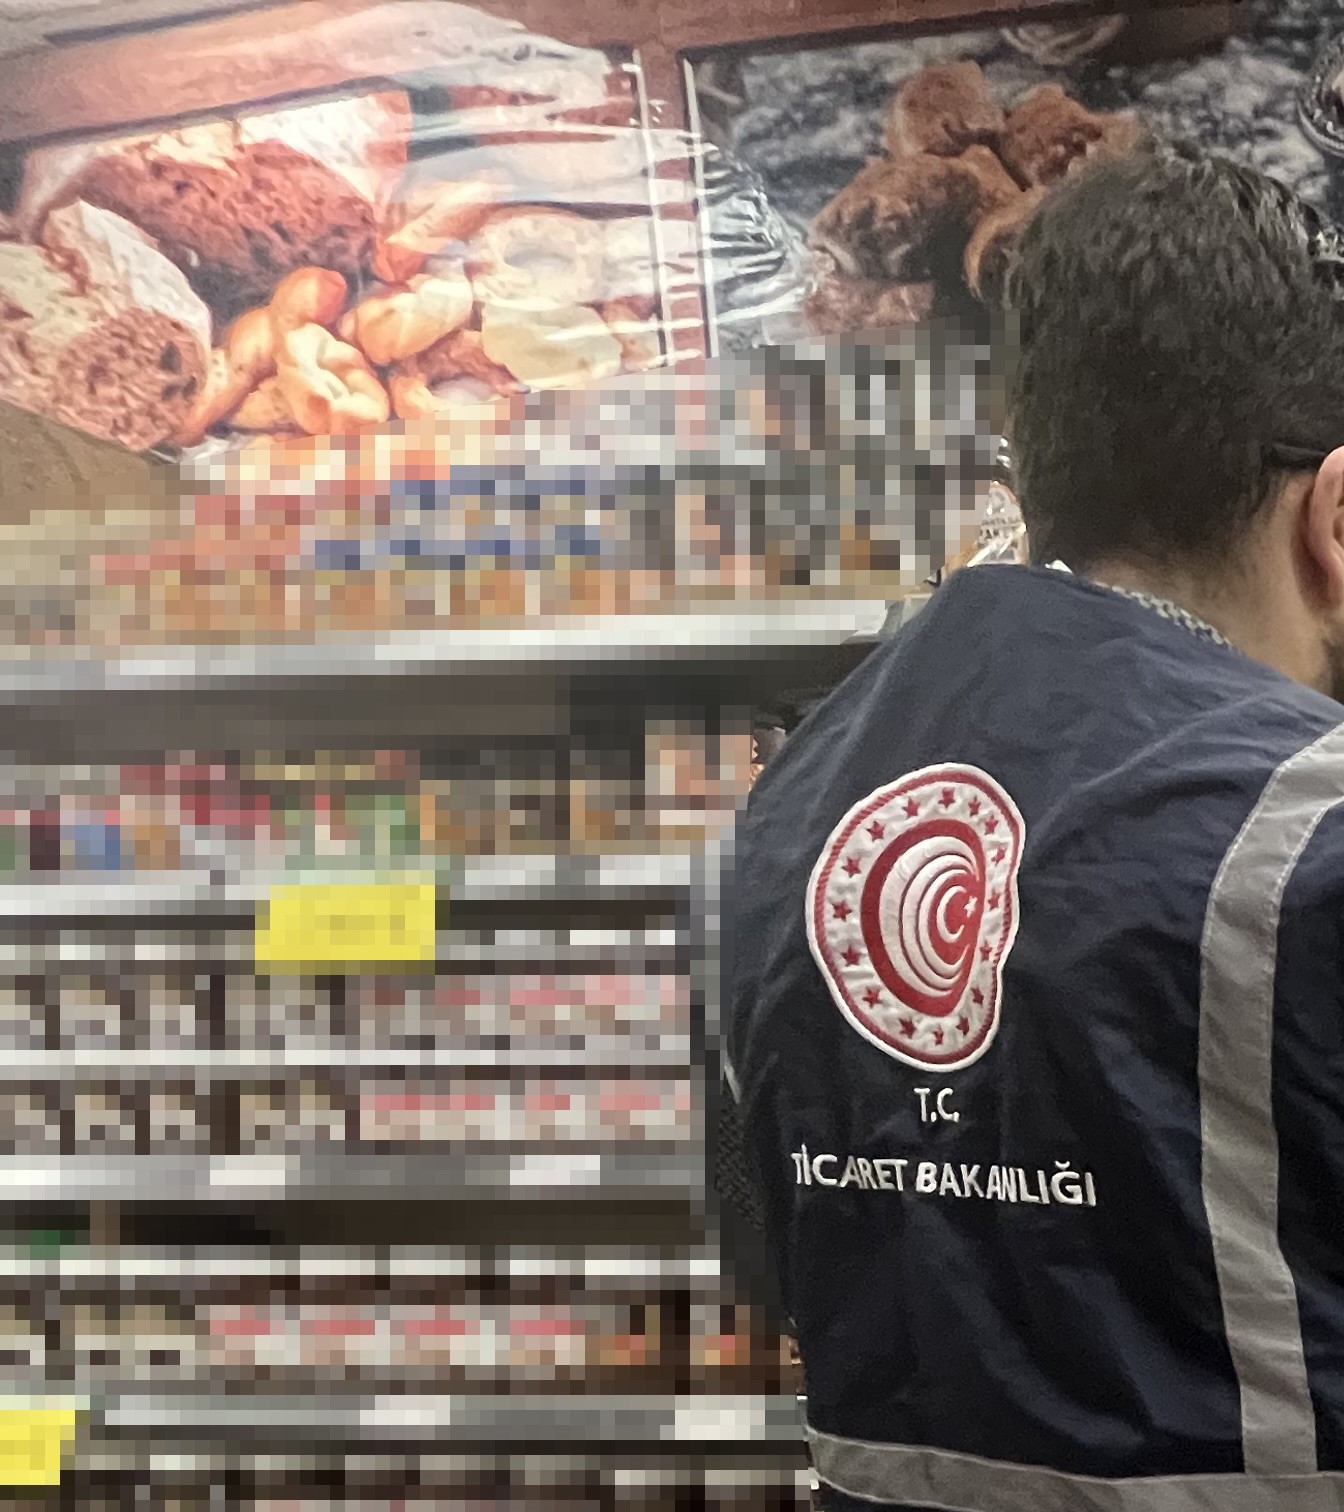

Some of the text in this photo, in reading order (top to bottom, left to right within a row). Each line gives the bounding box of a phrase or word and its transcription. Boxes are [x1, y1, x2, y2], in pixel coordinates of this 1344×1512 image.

[914, 1087, 960, 1122] T.C.
[791, 1143, 1097, 1207] TİCARET BAKANLIĞI
